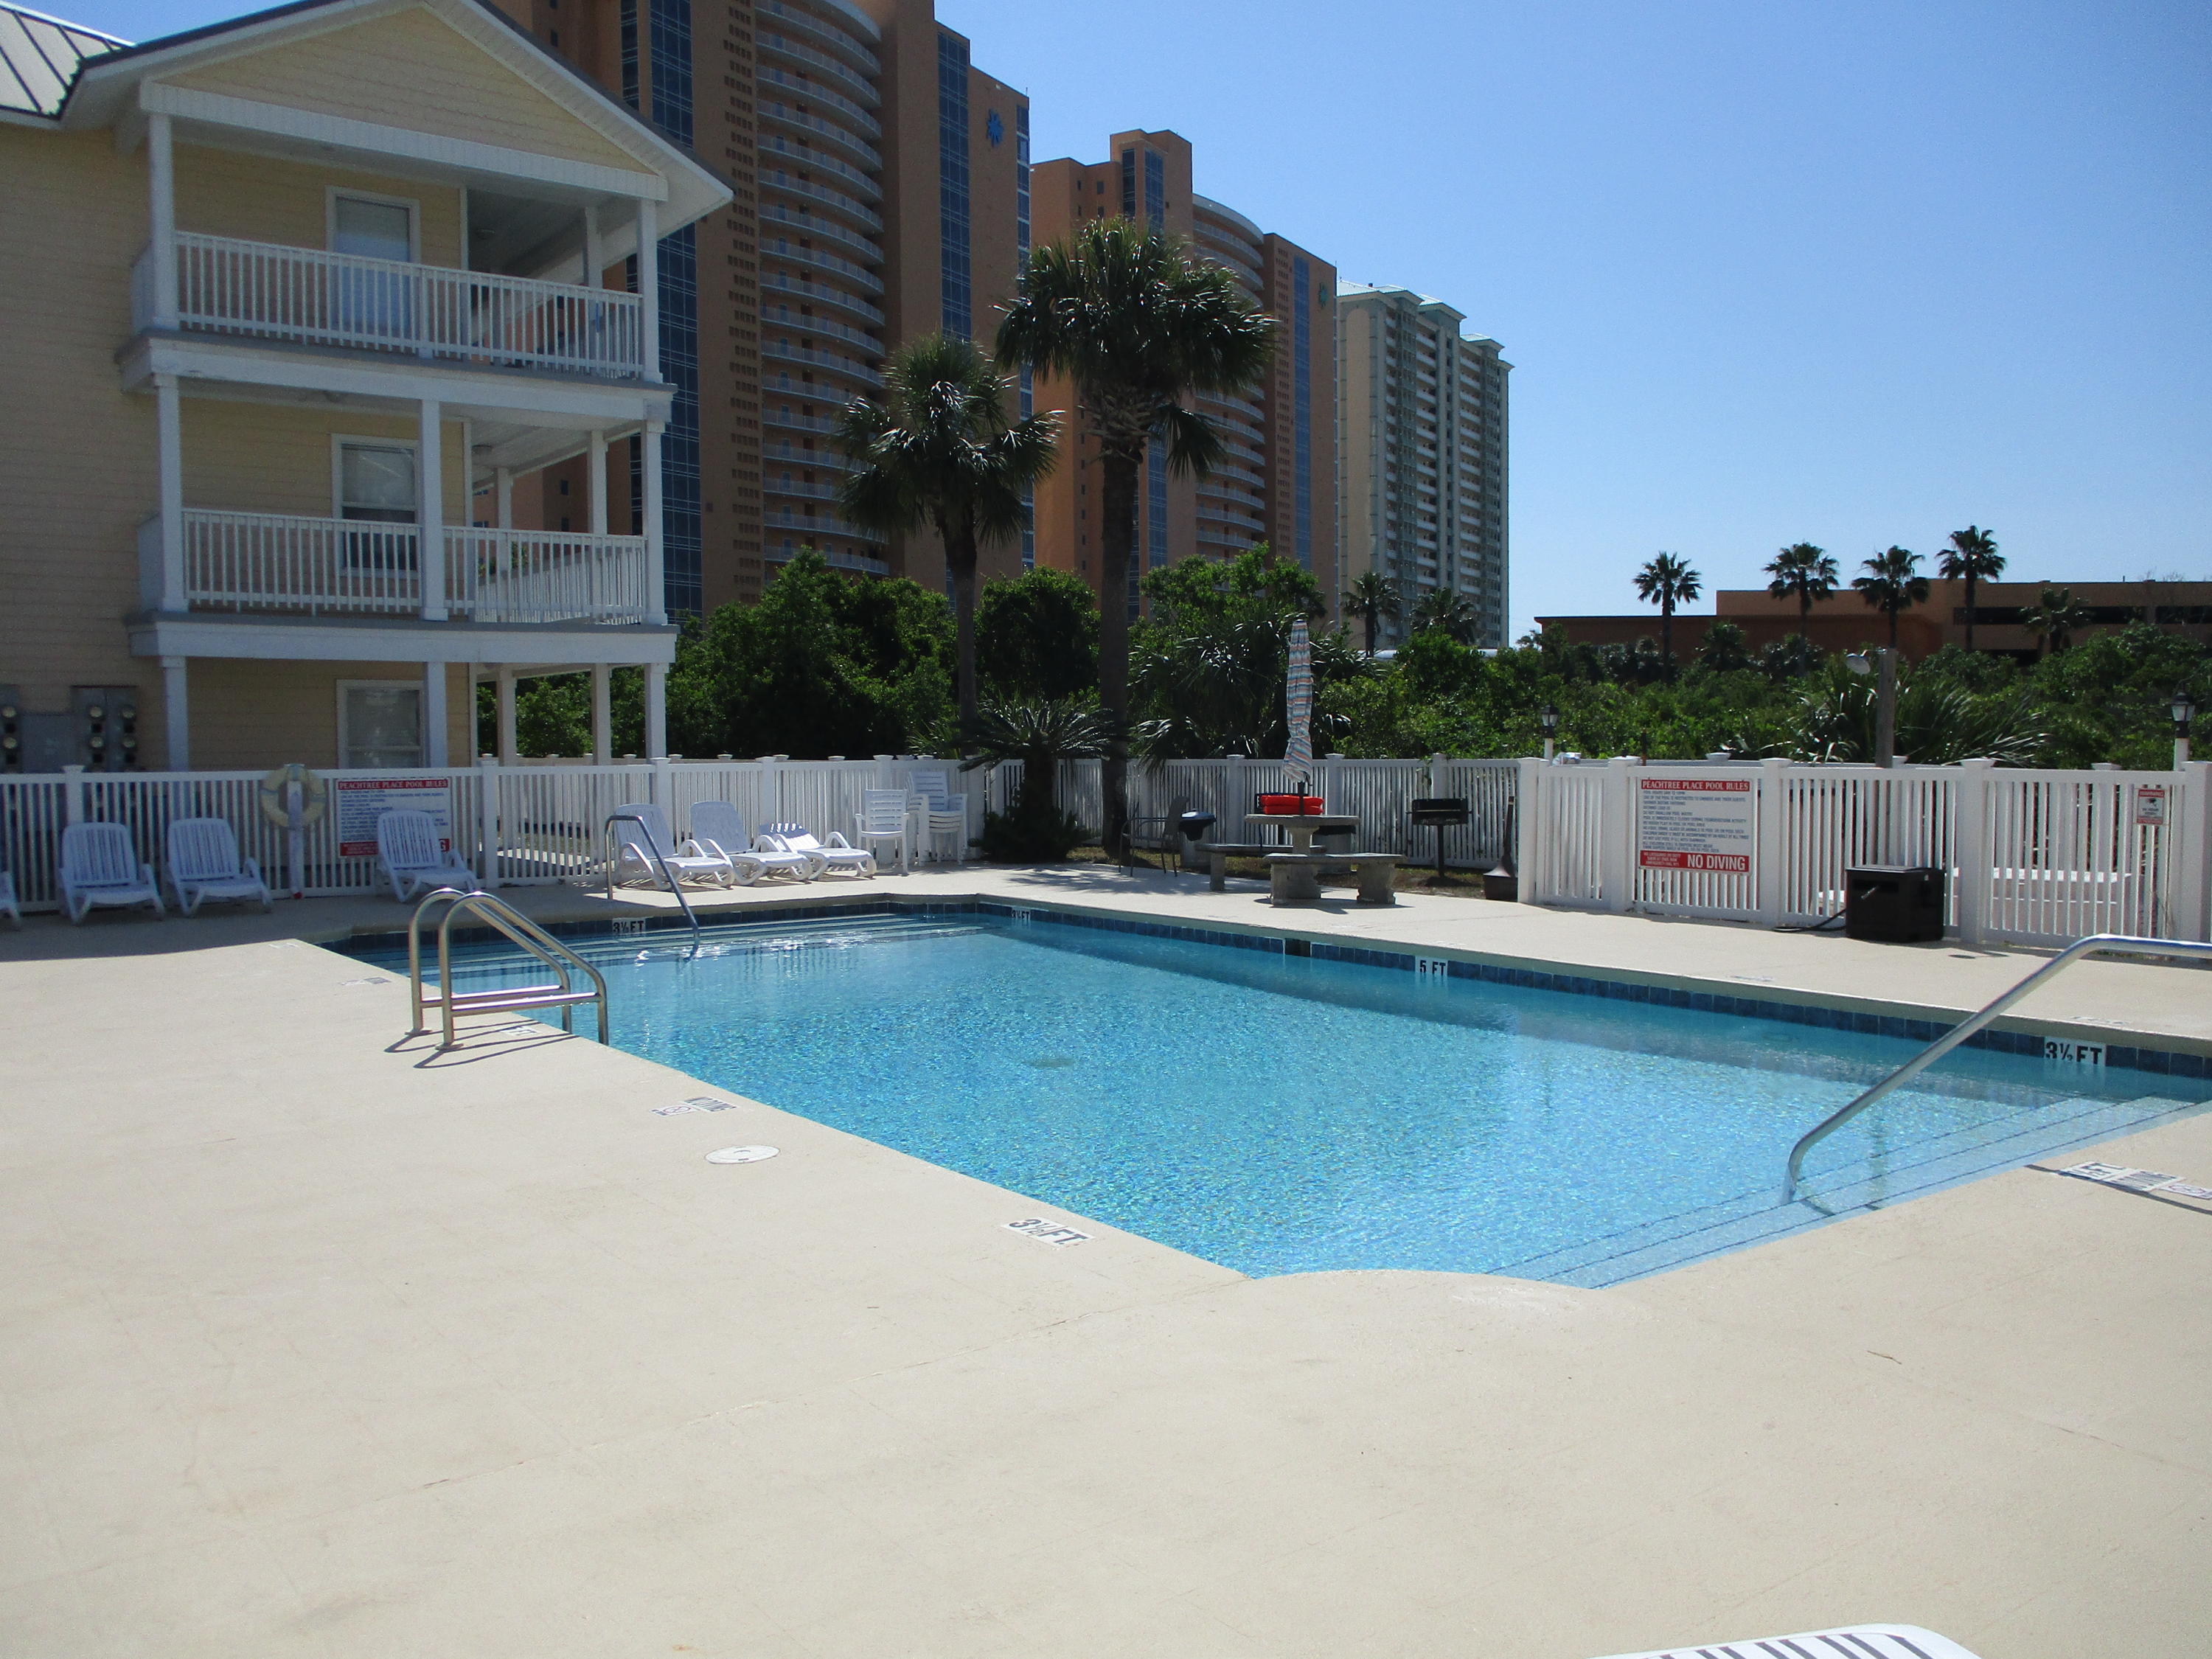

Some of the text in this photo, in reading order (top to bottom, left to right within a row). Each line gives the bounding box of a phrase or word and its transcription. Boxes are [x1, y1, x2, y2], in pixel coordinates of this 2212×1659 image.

[425, 779, 448, 787] RULES
[1642, 780, 1748, 791] PEACHTREE PLACE POOL RULES
[1687, 854, 1745, 871] NO DIVING
[1419, 960, 1446, 975] 5 FT
[2076, 1046, 2102, 1065] FT
